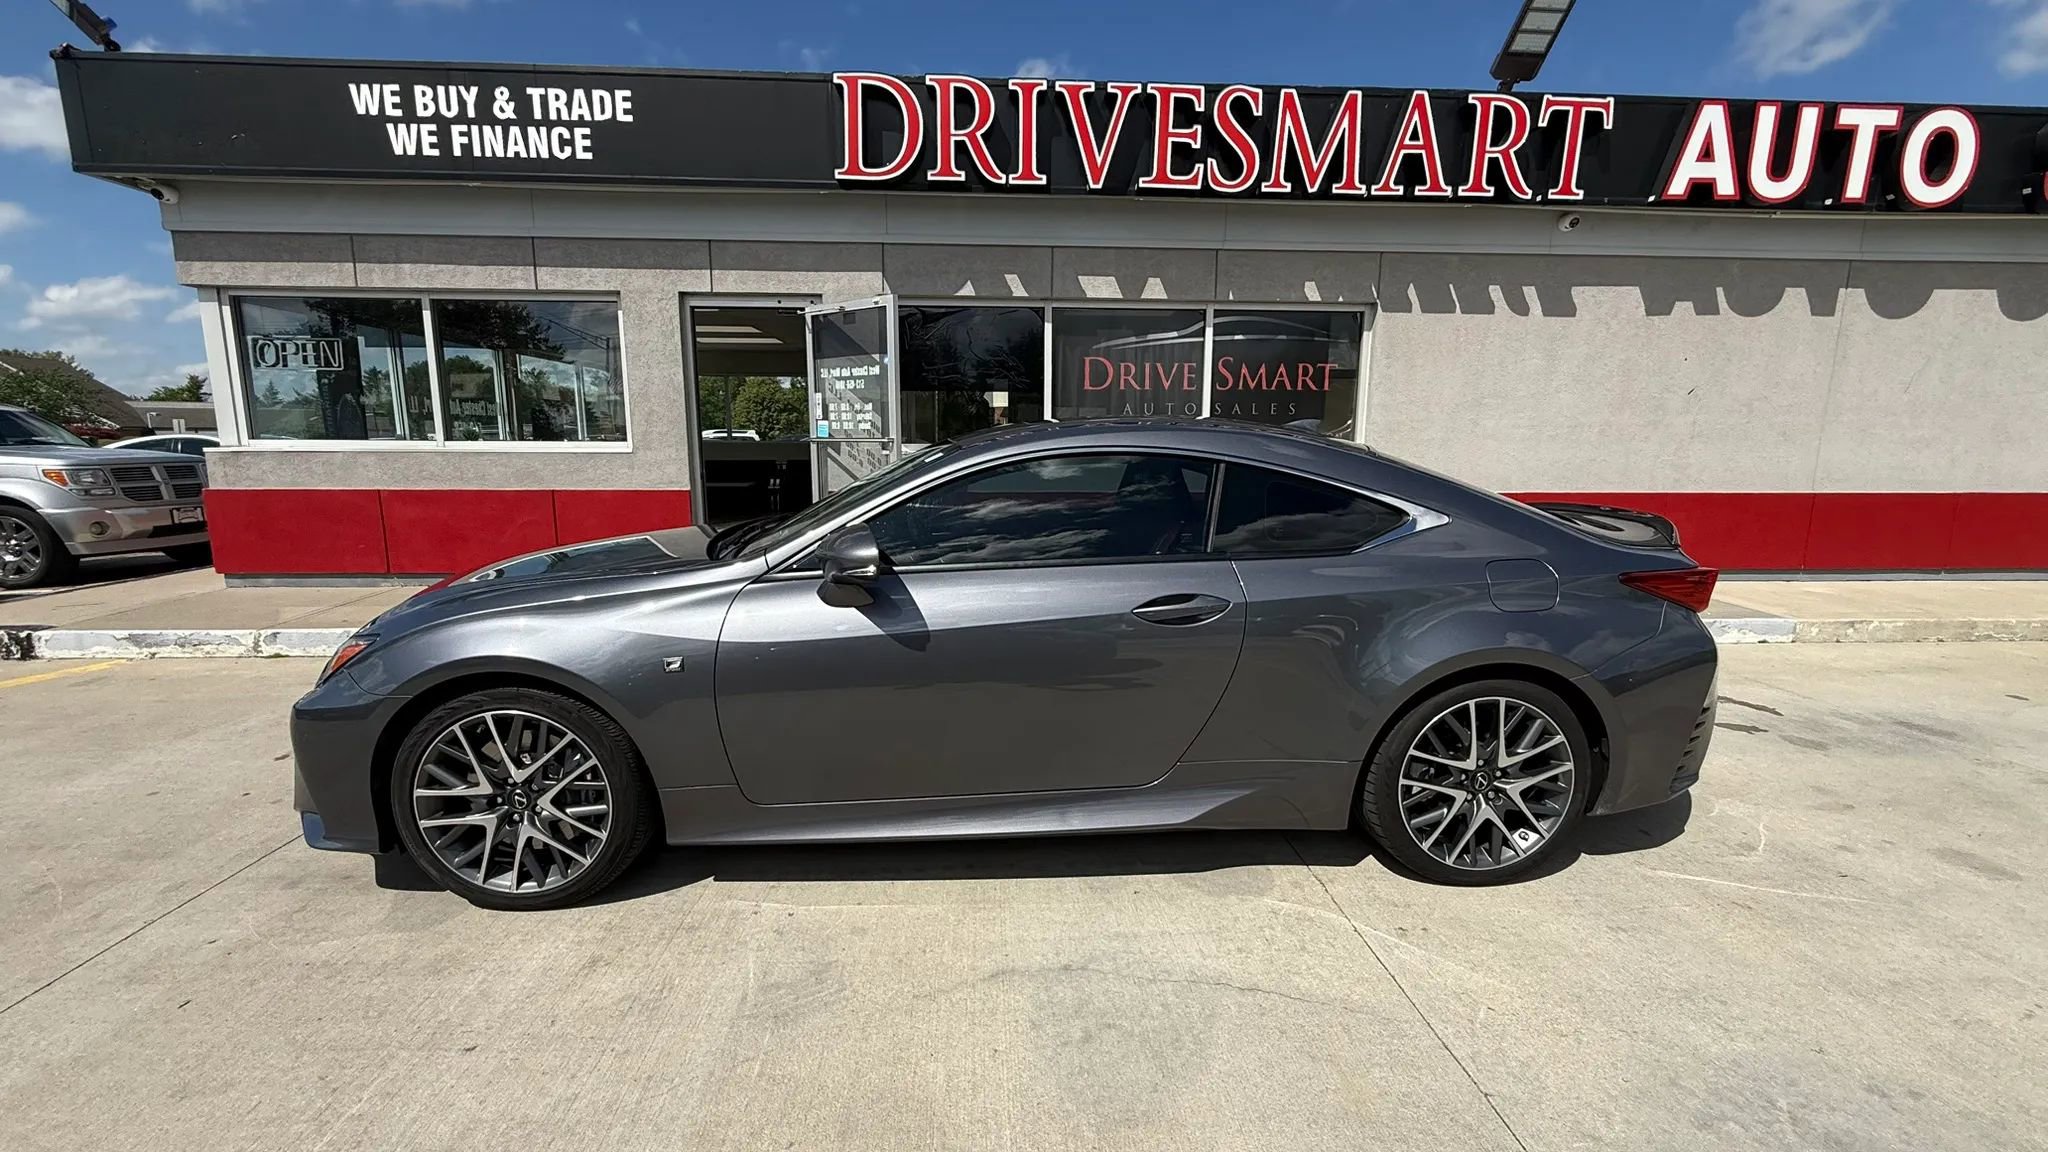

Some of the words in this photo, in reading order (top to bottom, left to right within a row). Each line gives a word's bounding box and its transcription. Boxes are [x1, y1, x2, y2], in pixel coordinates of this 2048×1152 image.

[348, 83, 403, 117] WE
[413, 85, 479, 119] BUY
[492, 86, 517, 120] &
[526, 87, 634, 123] TRADE
[386, 123, 440, 157] WE
[450, 124, 594, 160] FINANCE
[832, 70, 1615, 203] DRIVESMART
[1662, 98, 1981, 208] AUTO
[256, 339, 340, 368] OPEN
[1123, 402, 1197, 416] AUTO
[1213, 402, 1297, 416] SALES
